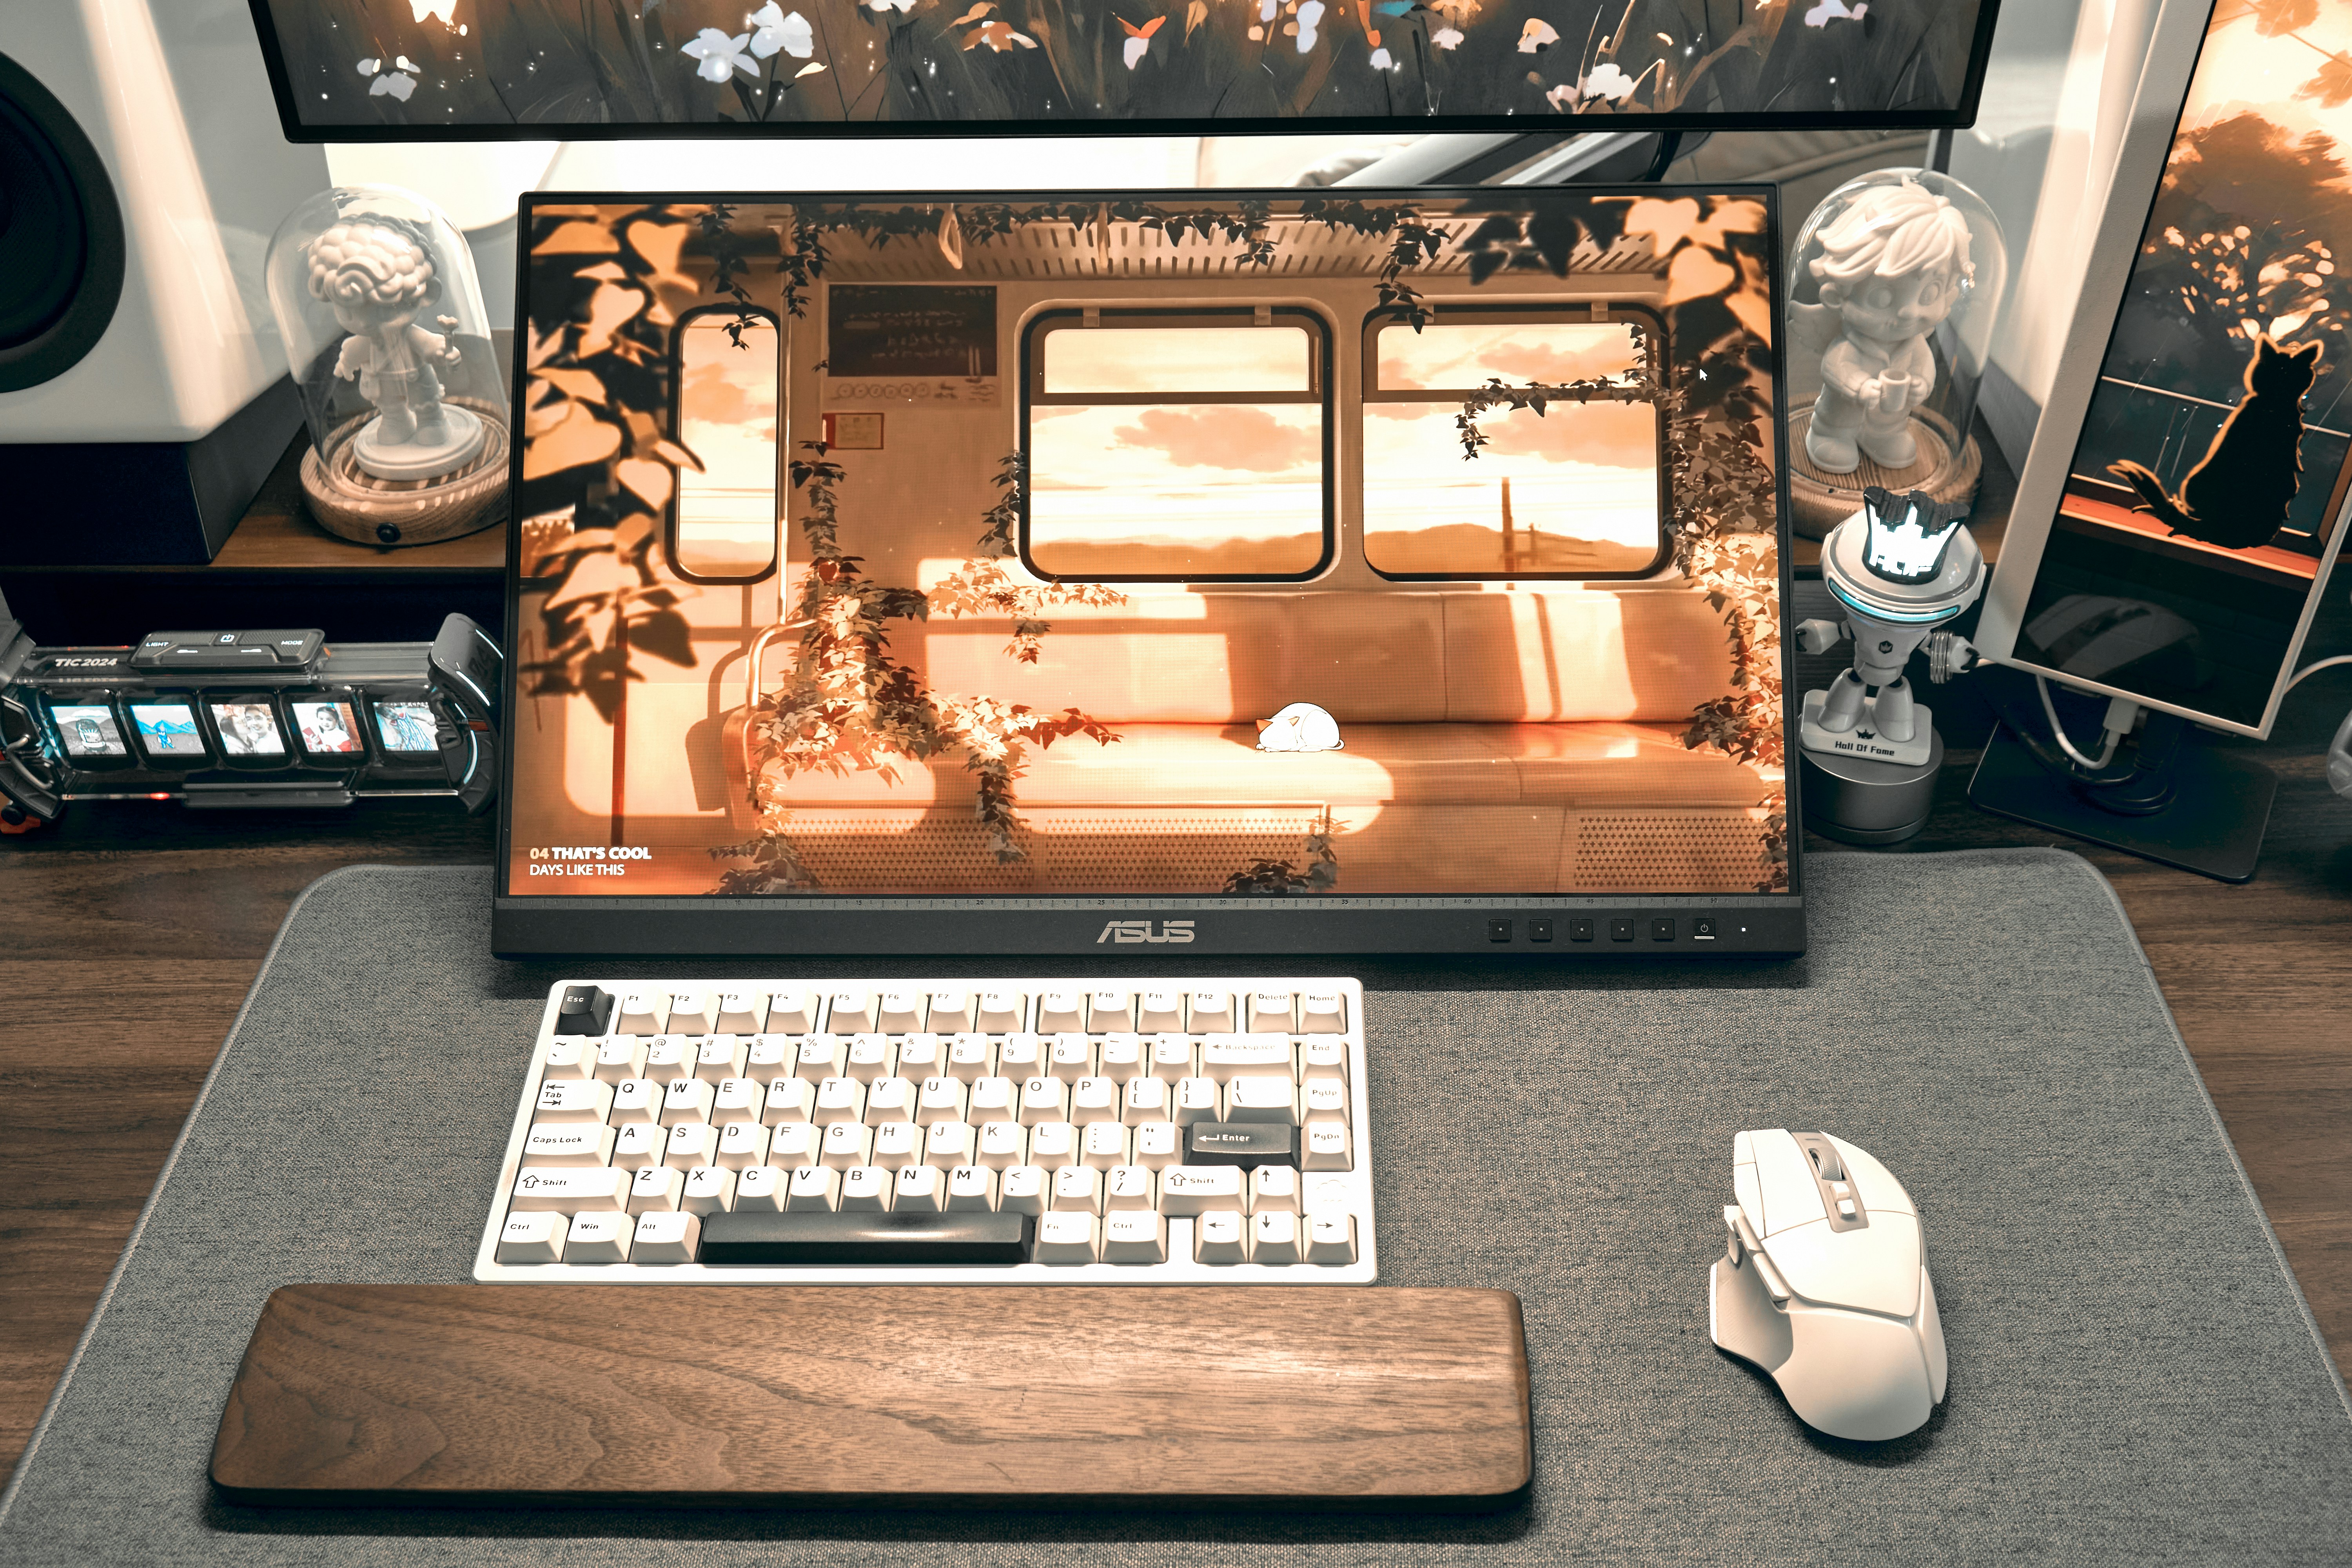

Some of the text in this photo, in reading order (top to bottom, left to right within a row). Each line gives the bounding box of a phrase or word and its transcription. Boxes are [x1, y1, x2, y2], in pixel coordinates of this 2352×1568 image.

[81, 658, 118, 666] 2024
[1835, 741, 1895, 756] Hall Of Fame
[530, 847, 652, 859] 04 THAT'S COOL
[530, 864, 624, 875] DAYS LIKE THIS
[1097, 921, 1194, 943] ASUS
[622, 1083, 634, 1093] Q
[674, 1083, 688, 1093] W
[723, 1082, 733, 1093] E
[774, 1082, 785, 1092] R
[827, 1082, 837, 1092] T
[878, 1082, 887, 1091] Y
[928, 1082, 938, 1091] U
[979, 1082, 982, 1091] I
[1031, 1082, 1042, 1091] O
[1082, 1081, 1091, 1091] P
[624, 1128, 635, 1138] A
[676, 1127, 686, 1137] S
[728, 1127, 739, 1136] D
[781, 1127, 791, 1136] F
[832, 1127, 843, 1136] G
[884, 1127, 895, 1136] H
[935, 1127, 944, 1136] J
[988, 1126, 997, 1136] K
[1040, 1127, 1048, 1137] L
[640, 1171, 653, 1180] Z
[693, 1171, 704, 1181] X
[746, 1171, 758, 1180] C
[800, 1170, 811, 1180] V
[851, 1171, 862, 1180] B
[904, 1170, 916, 1180] N
[957, 1170, 971, 1180] M
